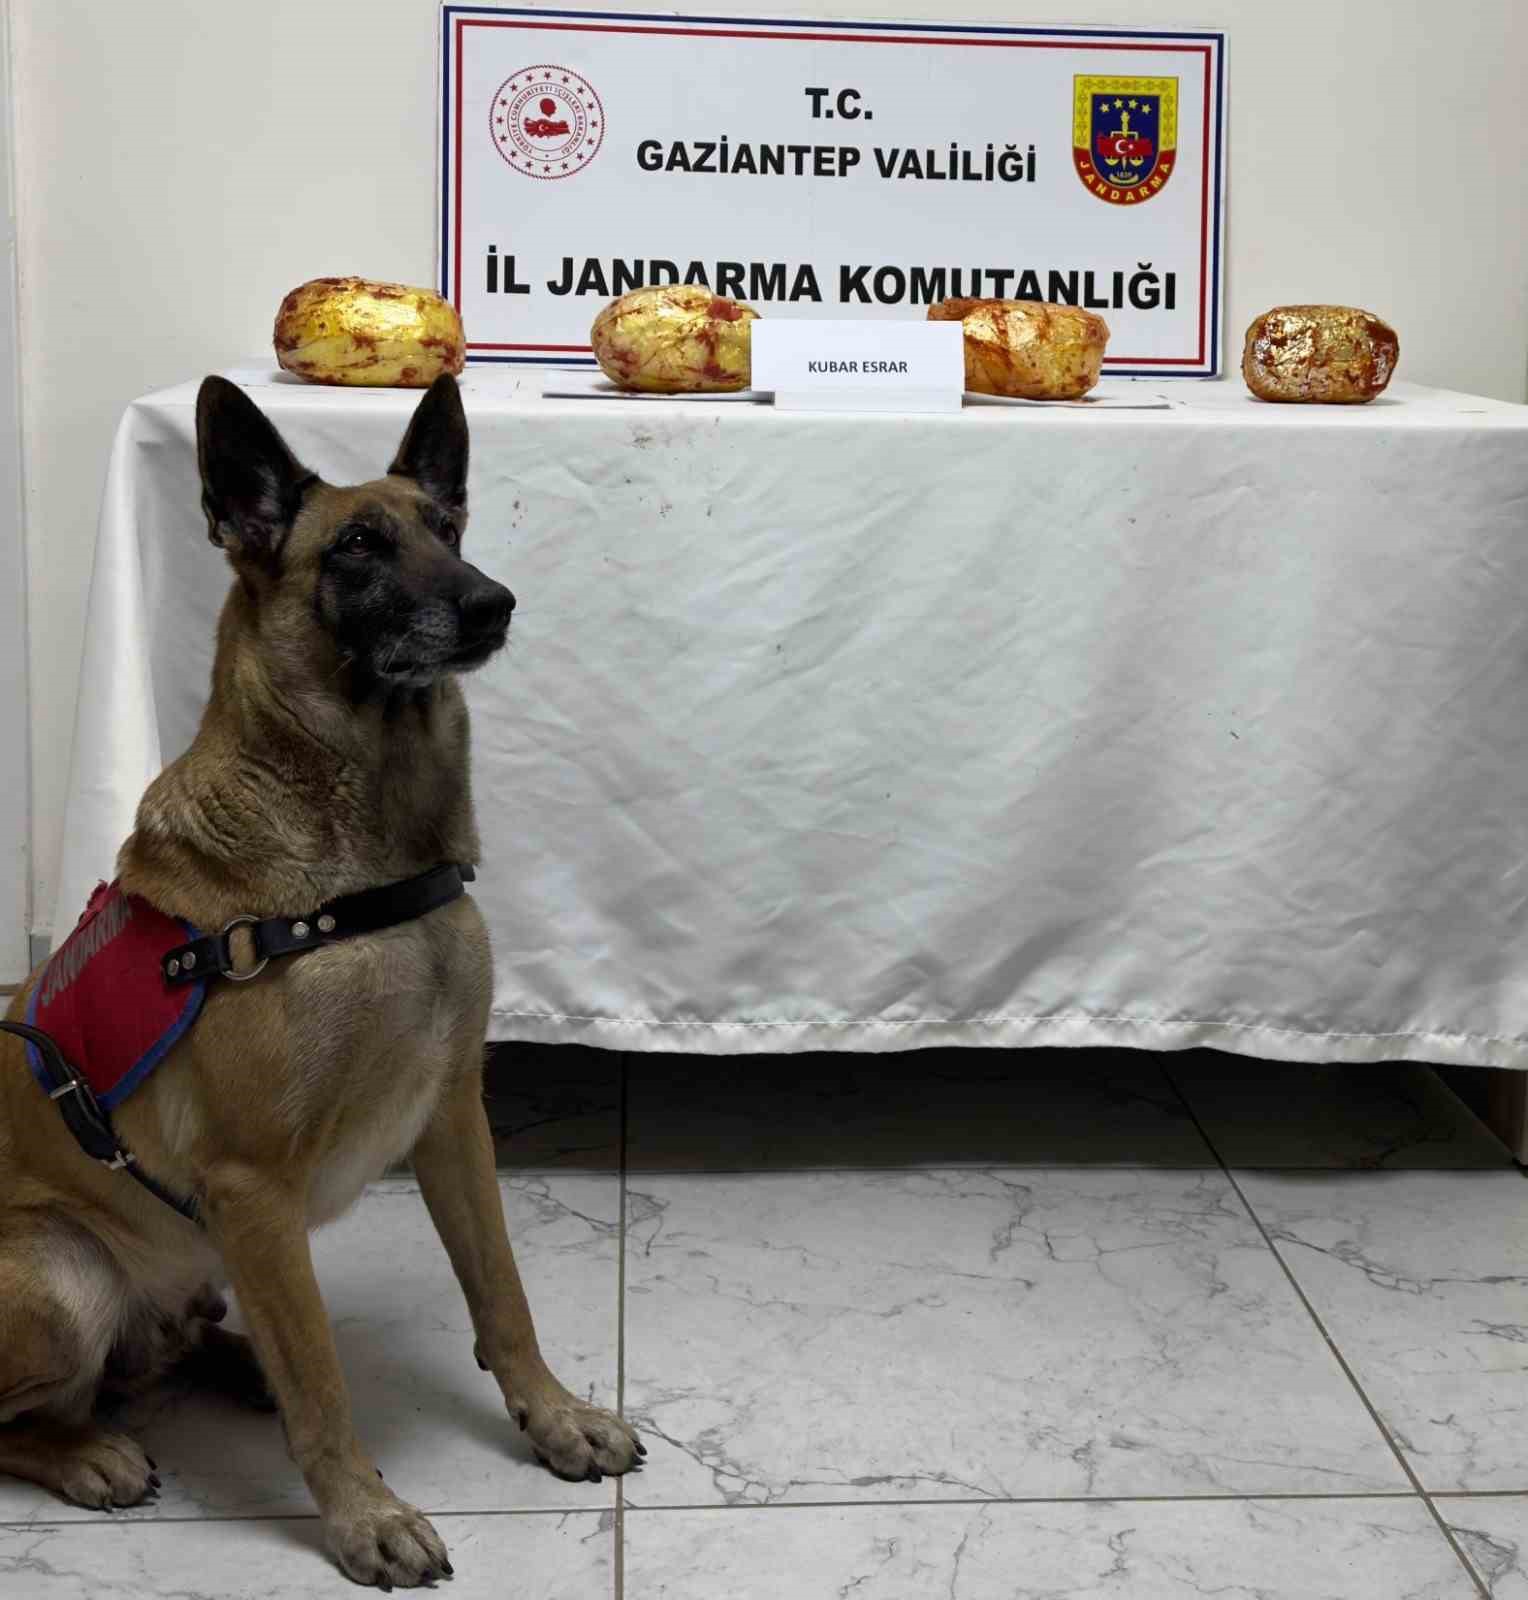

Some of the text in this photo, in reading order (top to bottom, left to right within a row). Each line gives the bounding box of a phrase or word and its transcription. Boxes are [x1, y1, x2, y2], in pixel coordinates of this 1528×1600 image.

[804, 87, 874, 120] T.C.
[636, 134, 1037, 183] GAZİANTEP VALİLİĞİ
[1080, 160, 1171, 201] JANDARMA
[486, 245, 1177, 310] İL JANDARMA KOMUTANLIĞI
[808, 361, 908, 373] KUBAR ESRAR
